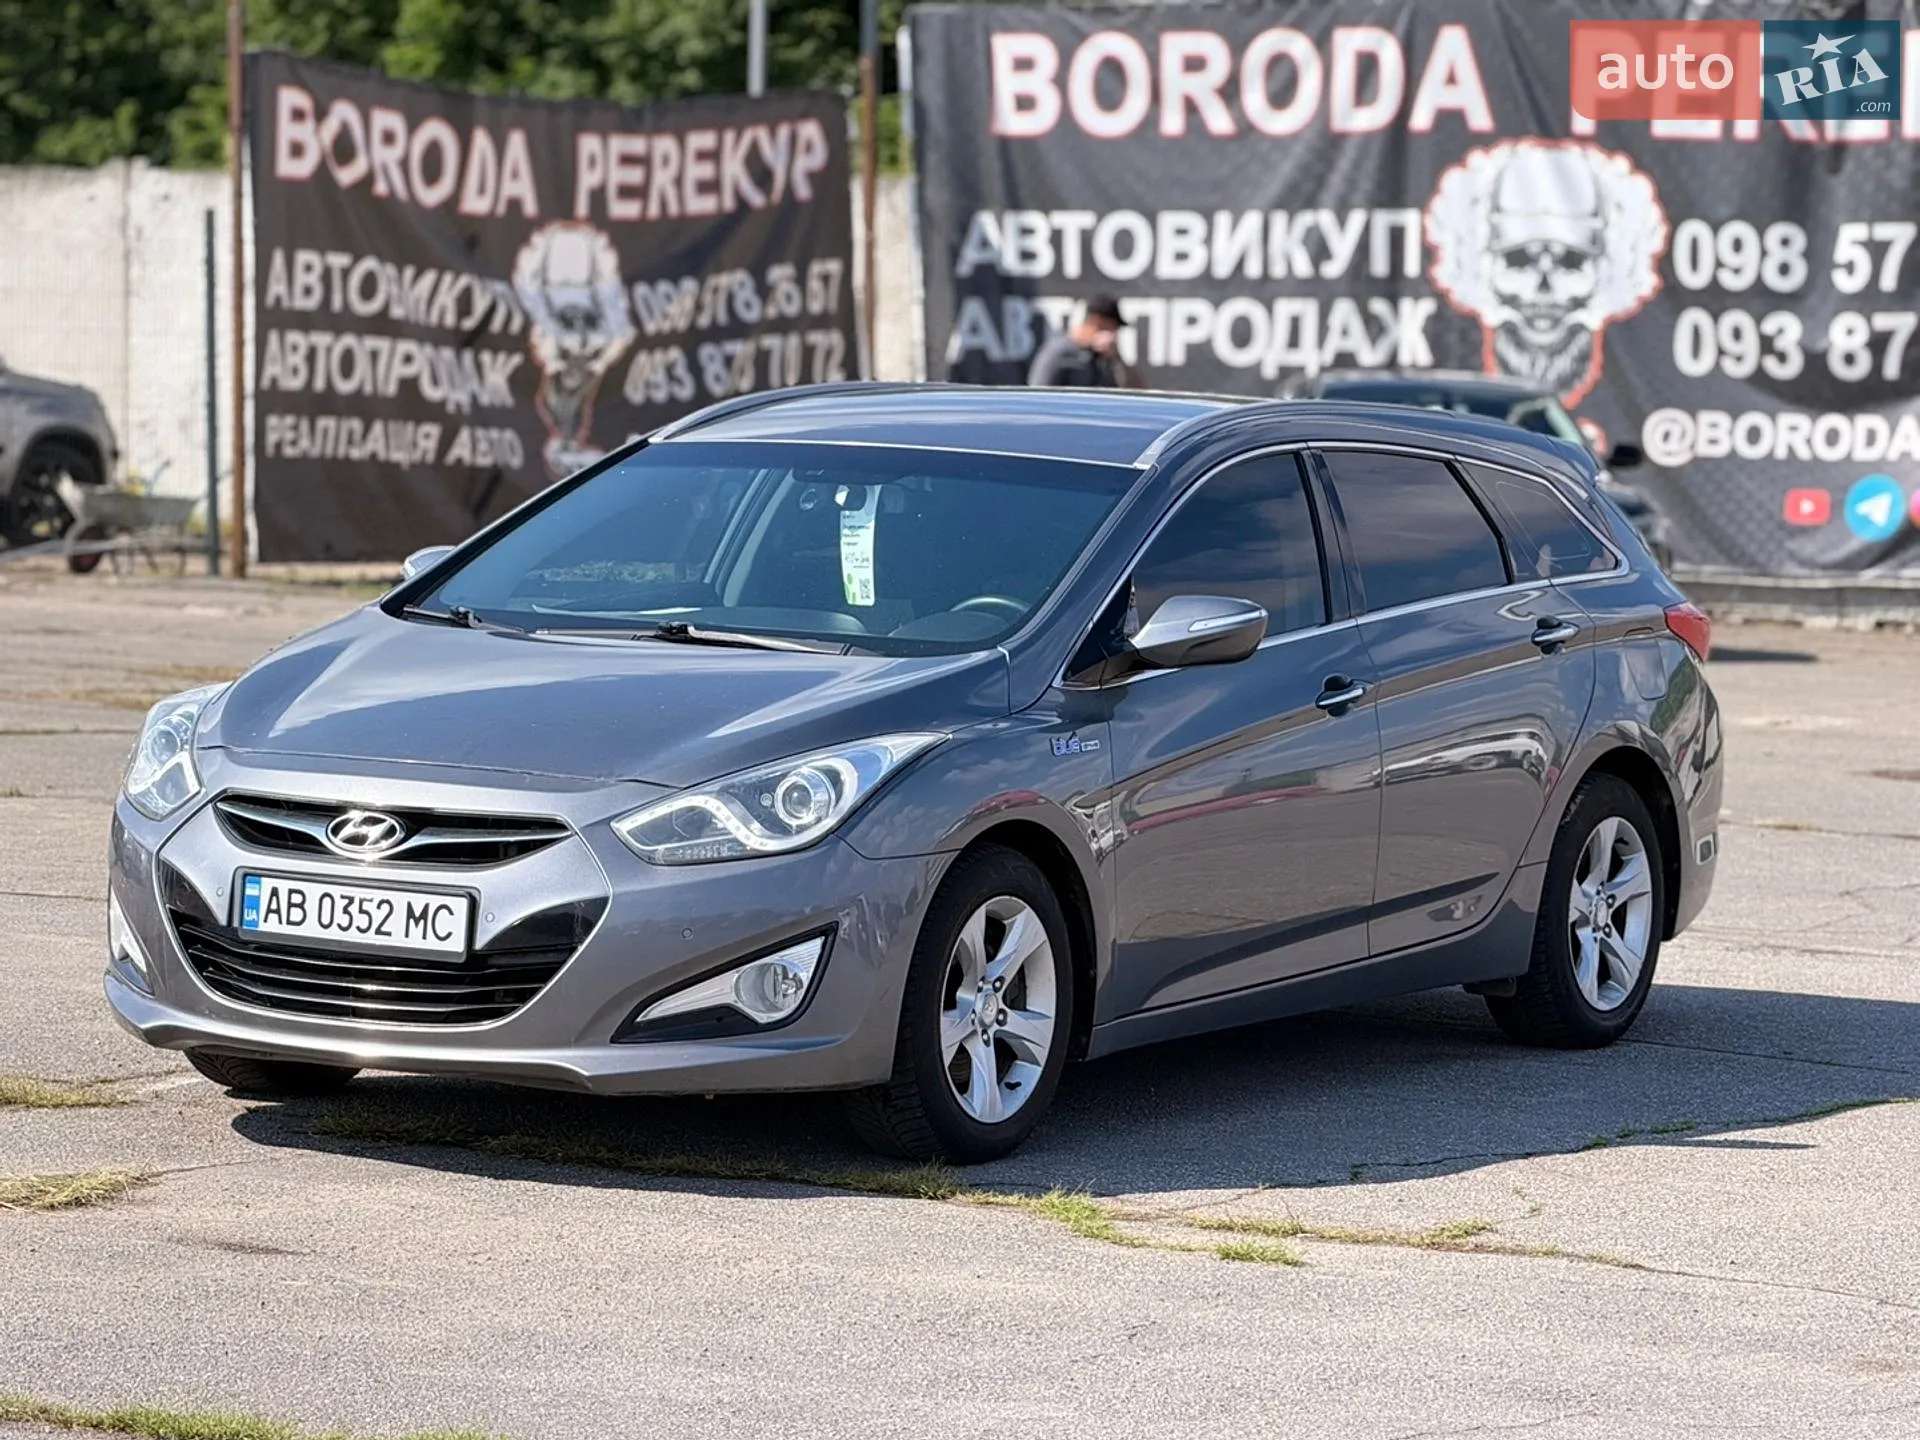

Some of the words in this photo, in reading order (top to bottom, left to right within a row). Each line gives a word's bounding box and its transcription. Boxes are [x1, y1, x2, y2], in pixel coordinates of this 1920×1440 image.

[990, 24, 1495, 138] BORODA
[1569, 27, 1920, 143] PERE
[276, 84, 538, 218] BORODA
[574, 117, 829, 220] PEREKYP
[956, 207, 1422, 280] АВТОВИКУП
[1672, 218, 1807, 293] 098
[1830, 221, 1918, 294] 57
[260, 327, 525, 414] АВТОПРОДАЖ
[945, 295, 1438, 380] АВТПРОДАЖ
[1672, 307, 1804, 381] 093
[1826, 310, 1918, 383] 87
[444, 424, 525, 470] АВТО
[1642, 407, 1920, 468] @BORODA
[244, 909, 258, 921] UA
[263, 886, 307, 926] AB
[317, 892, 395, 938] 0352
[404, 901, 455, 942] MC
